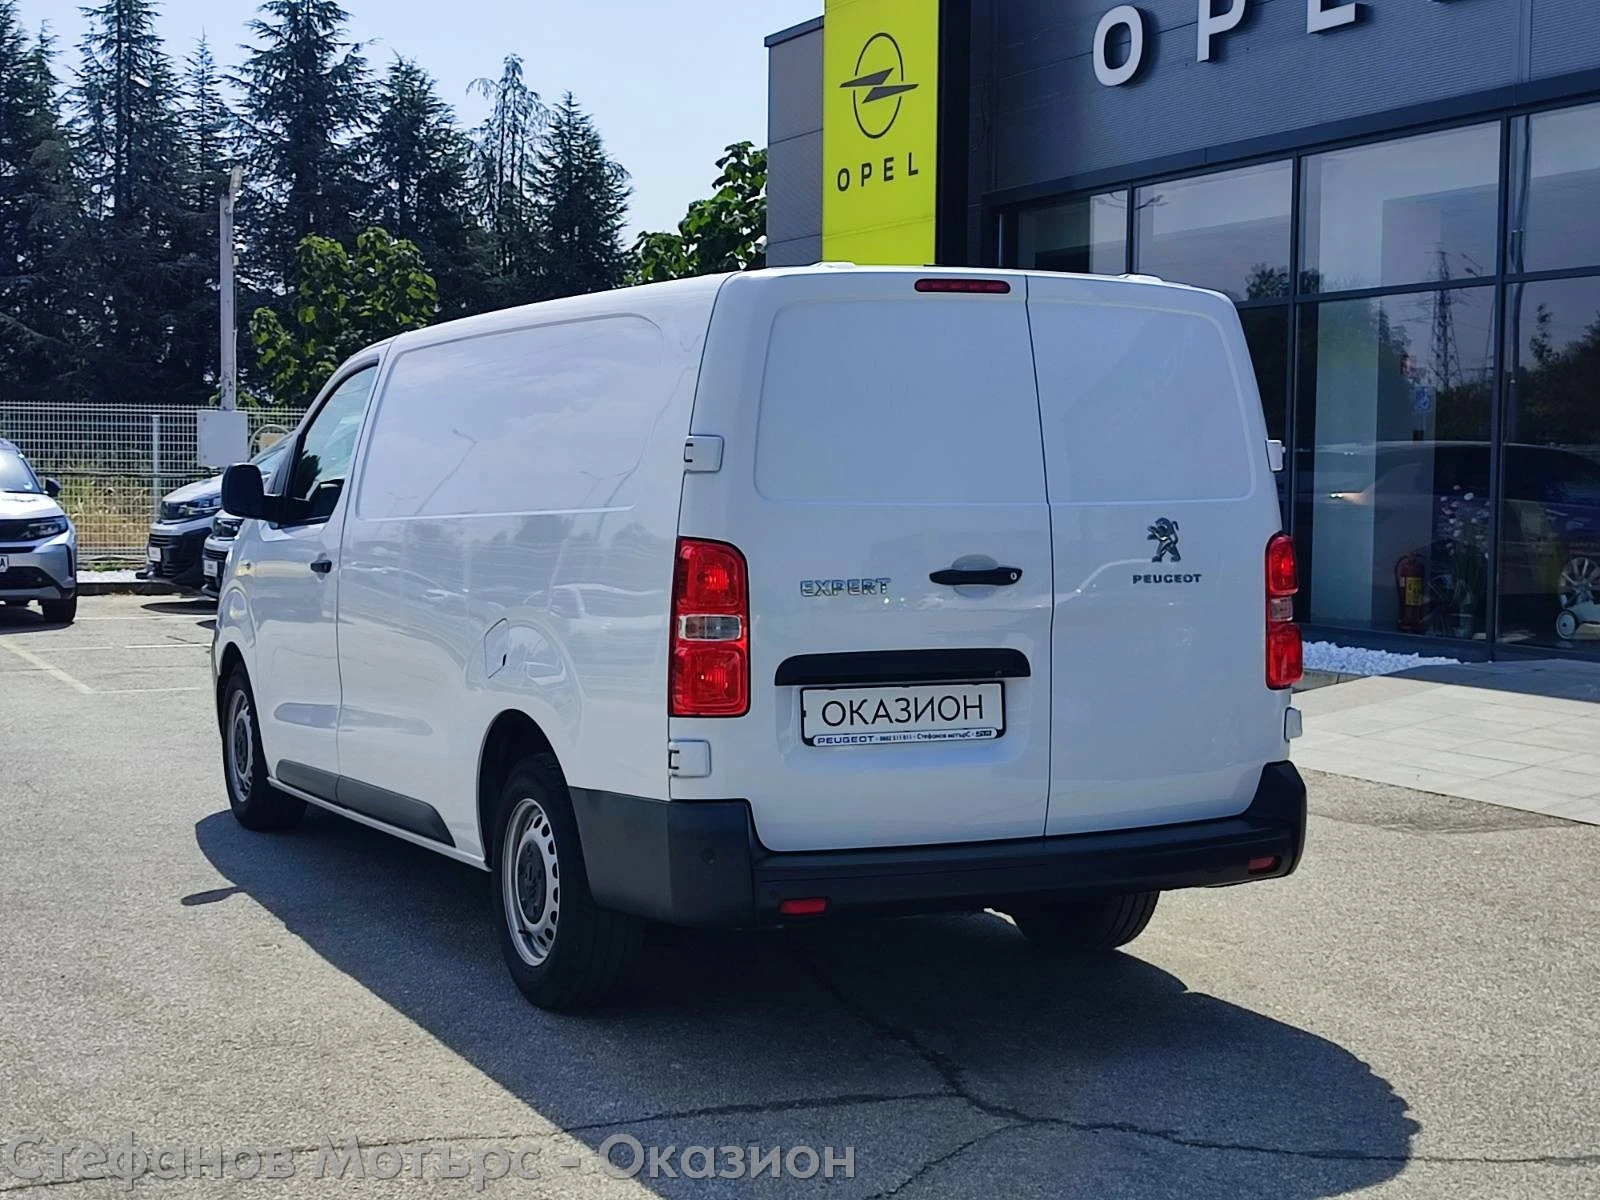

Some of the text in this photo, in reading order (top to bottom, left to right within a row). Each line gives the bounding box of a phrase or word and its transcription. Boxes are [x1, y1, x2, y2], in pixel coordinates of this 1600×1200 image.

[837, 152, 919, 192] OPEL
[800, 578, 891, 597] EXPERT
[1132, 574, 1203, 584] PEUGEOT
[821, 694, 984, 727] ОКАЗИОН
[817, 735, 875, 744] PEUGEOT
